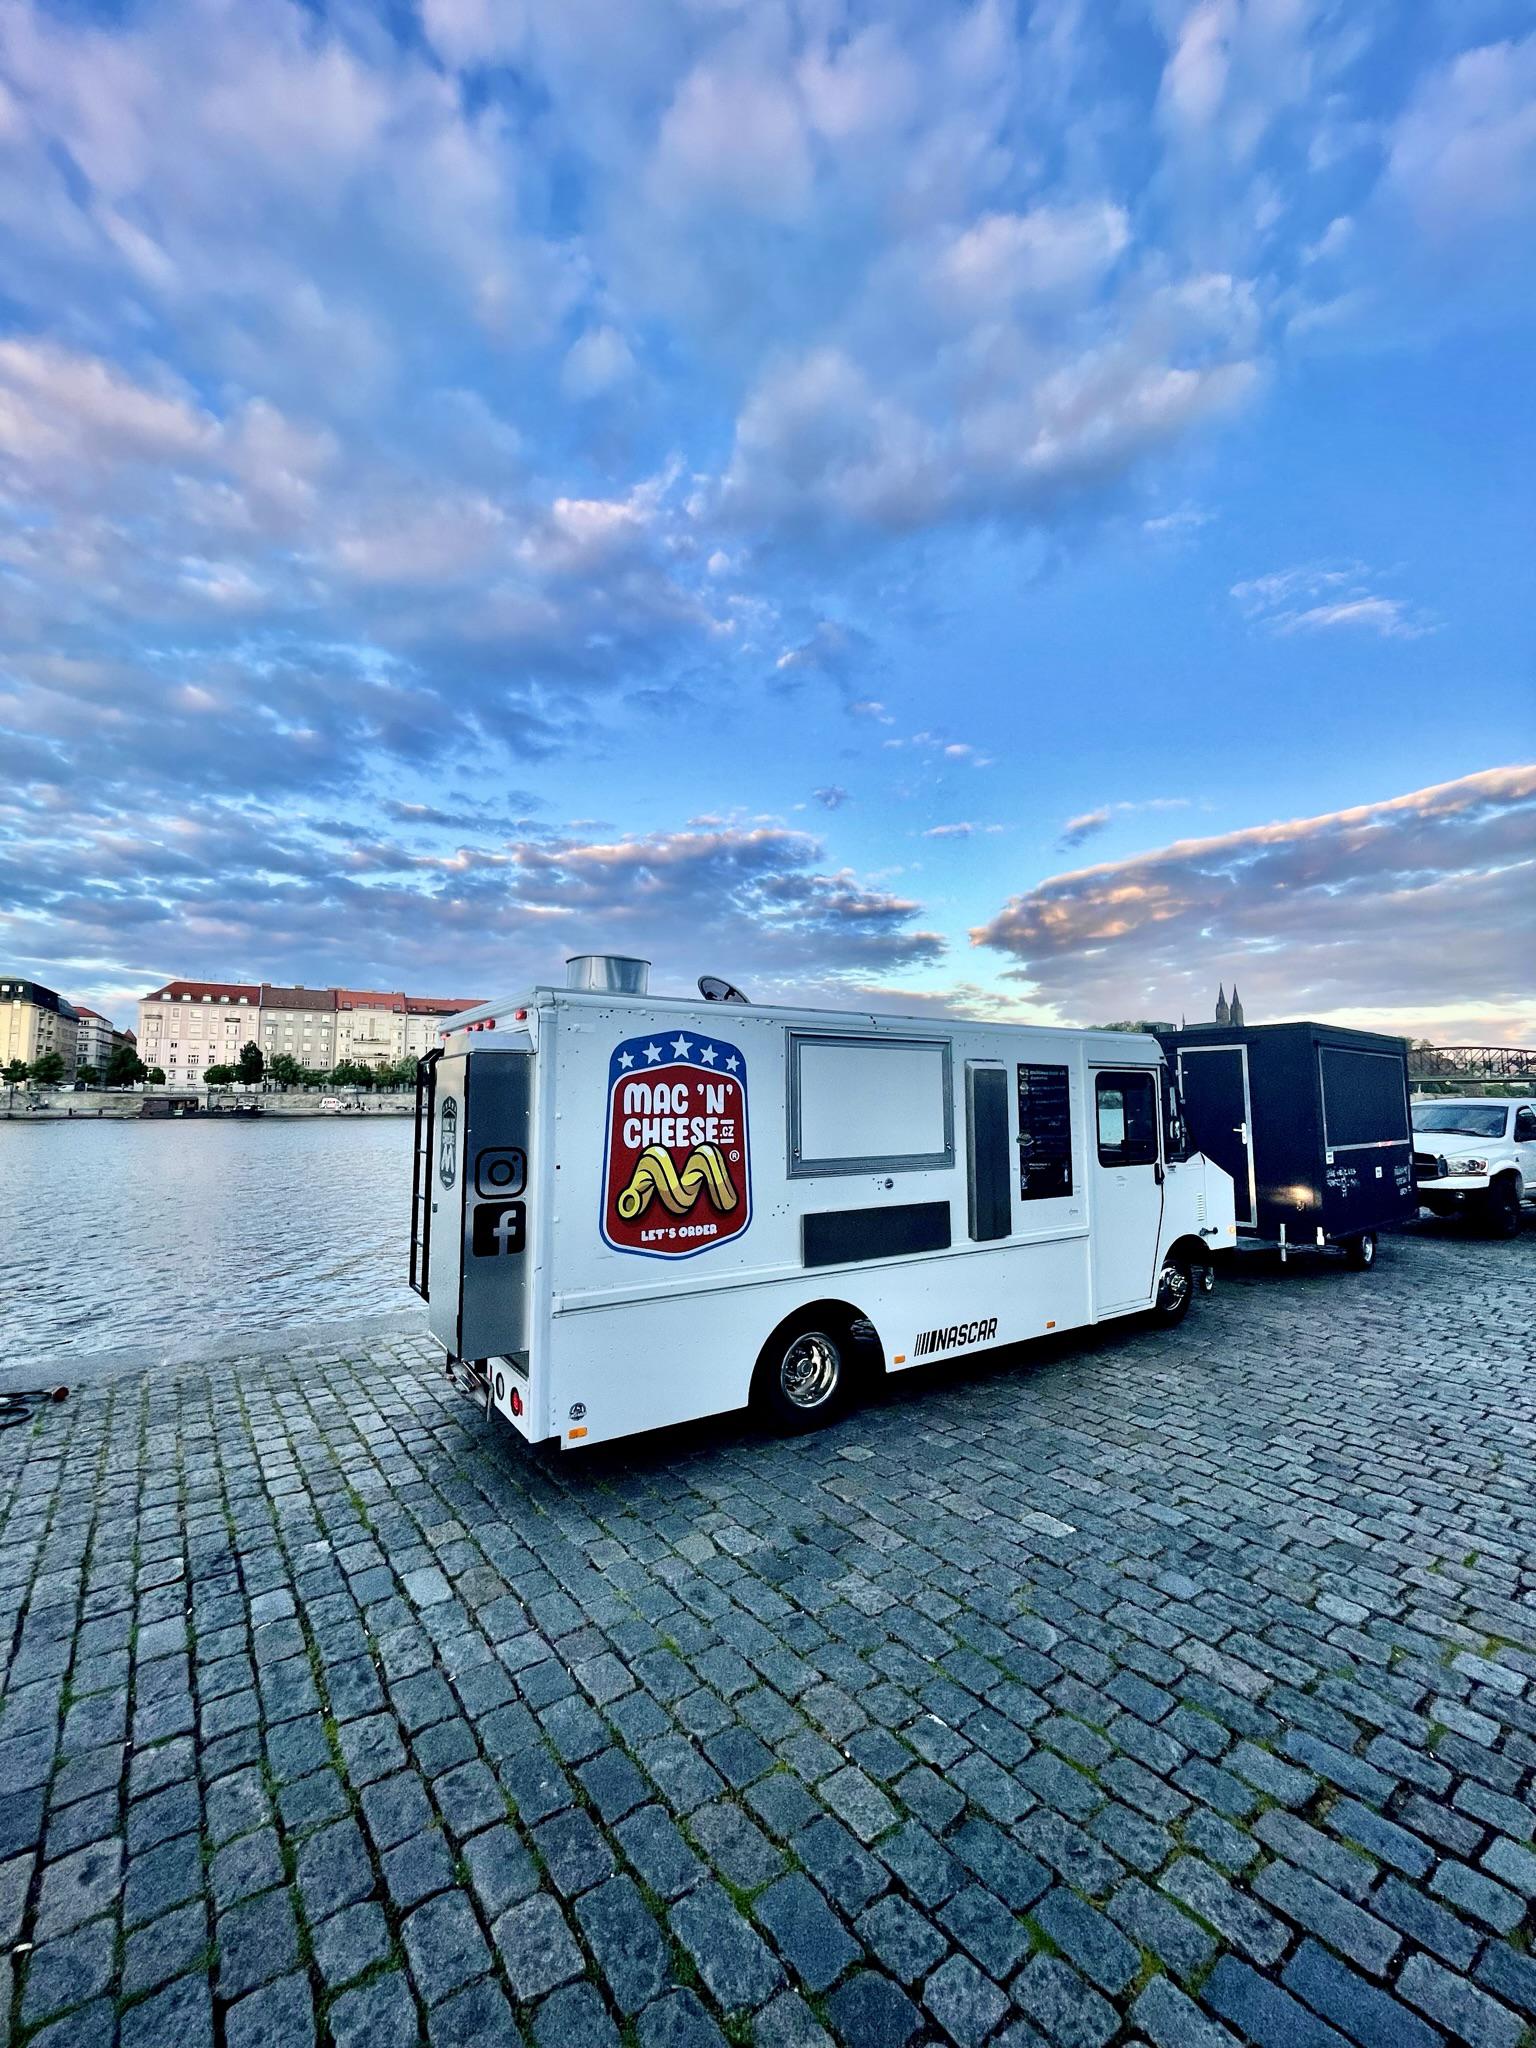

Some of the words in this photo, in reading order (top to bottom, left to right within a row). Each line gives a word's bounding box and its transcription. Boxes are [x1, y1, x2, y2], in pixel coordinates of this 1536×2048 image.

[624, 1083, 688, 1114] MAC
[641, 1228, 677, 1241] LET'S
[678, 1224, 717, 1238] ORDER
[936, 1317, 997, 1351] NASCAR
